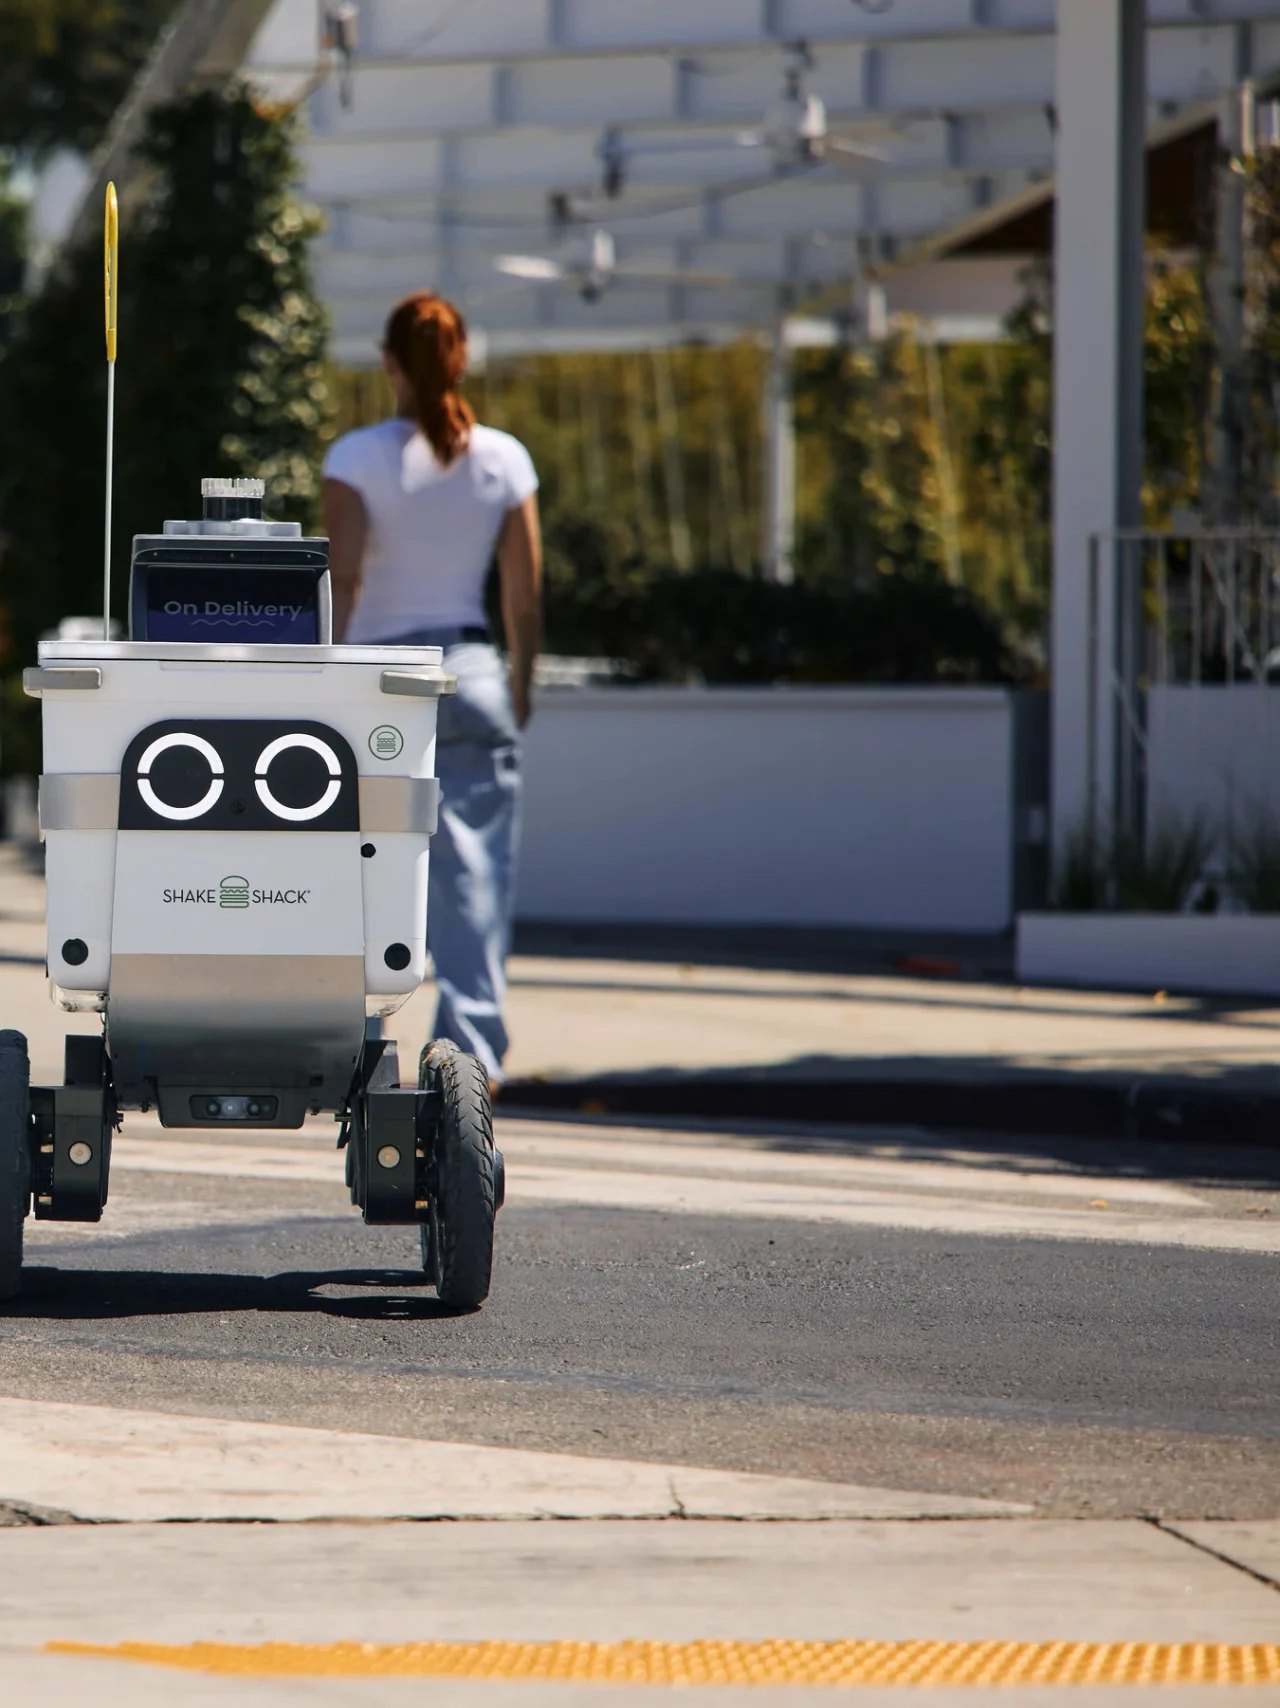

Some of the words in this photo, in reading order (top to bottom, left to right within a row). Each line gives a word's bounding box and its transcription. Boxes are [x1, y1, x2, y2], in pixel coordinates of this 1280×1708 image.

[164, 600, 198, 615] On
[205, 600, 303, 621] Delivery
[163, 889, 216, 903] SHAKE
